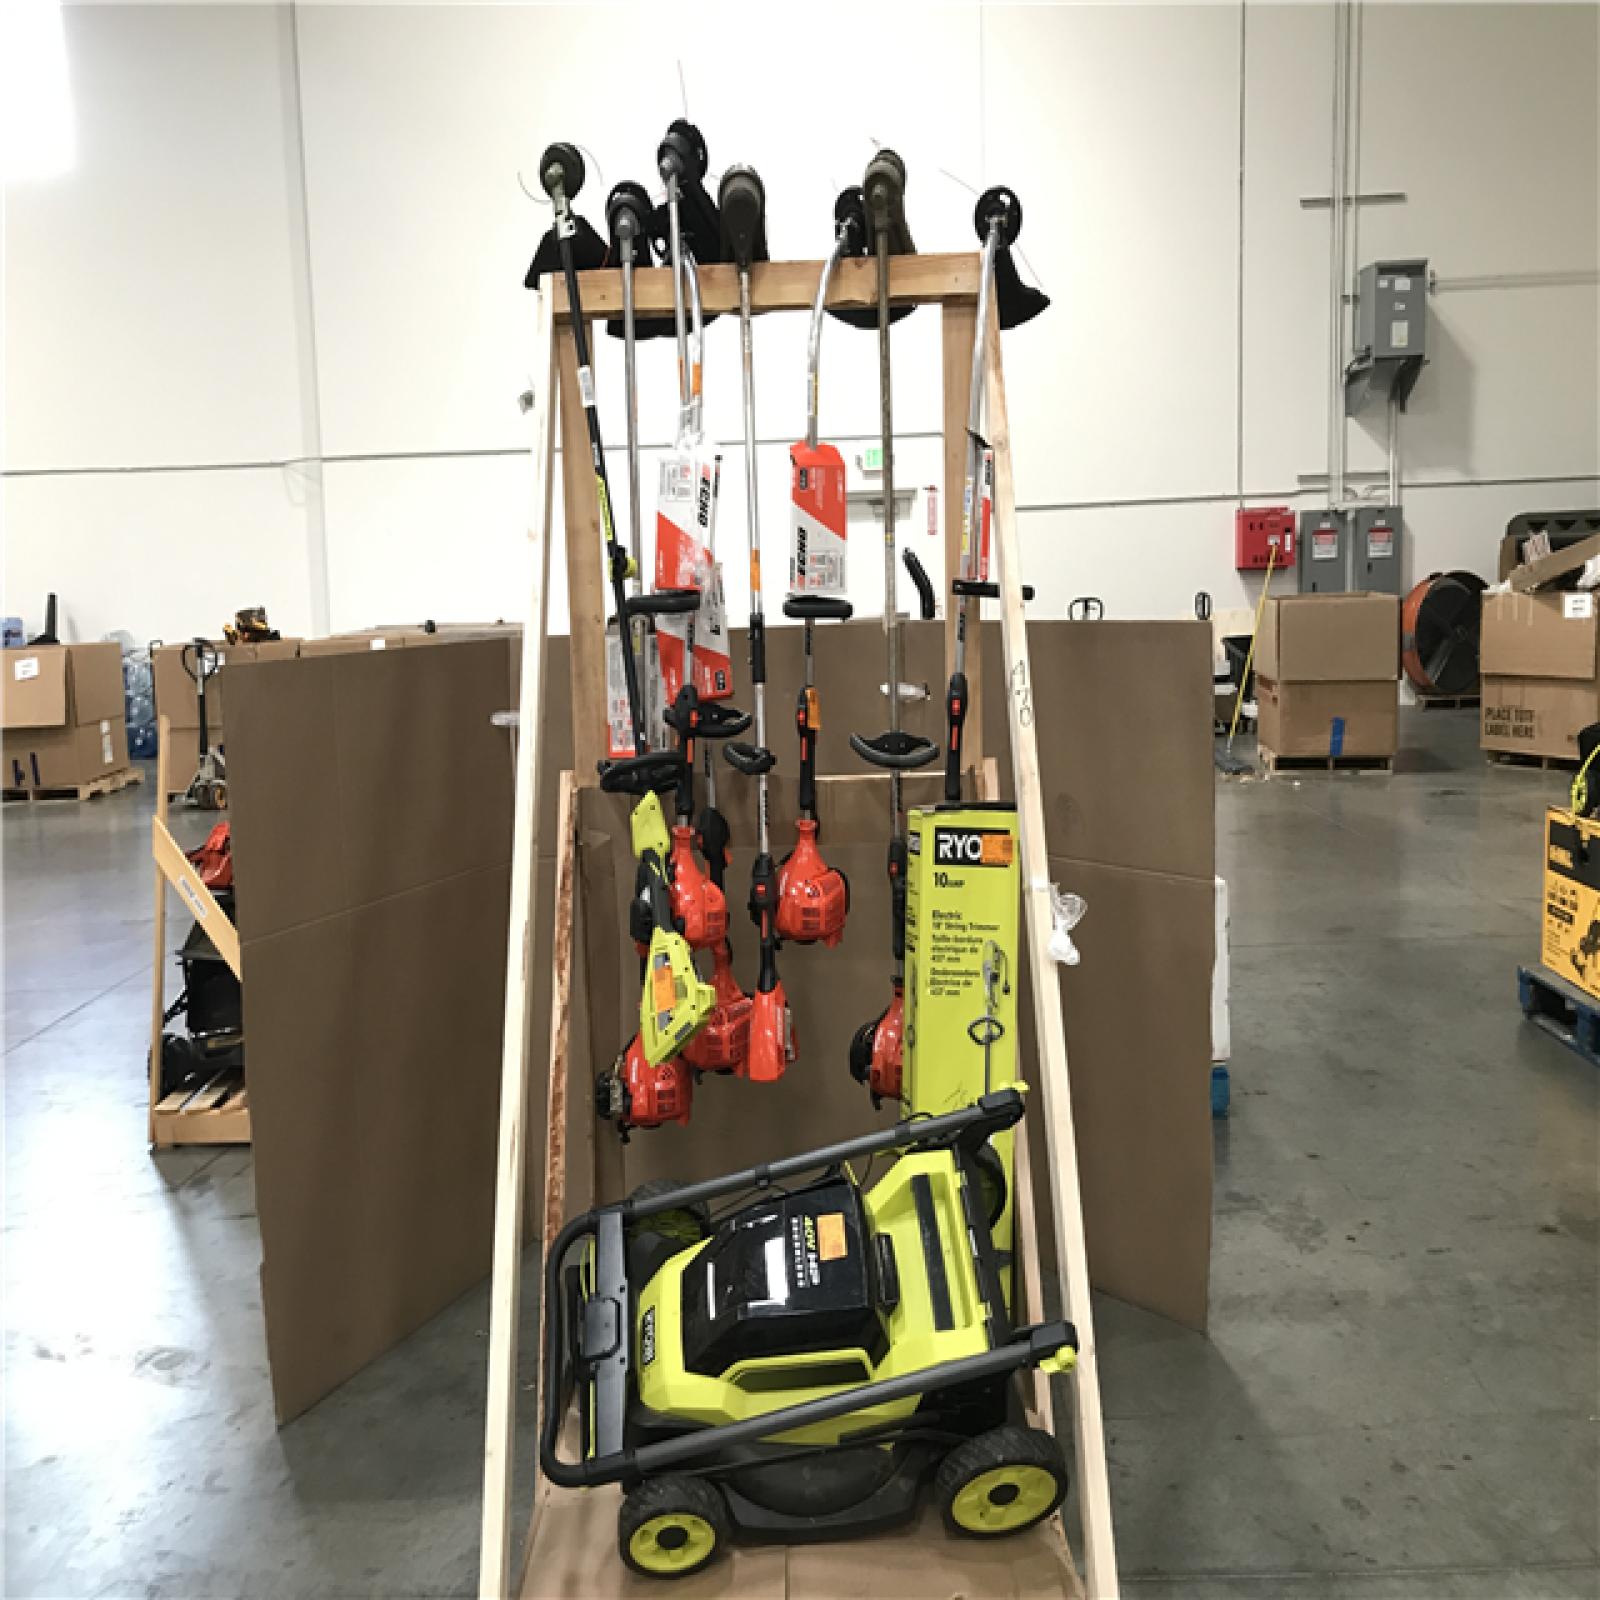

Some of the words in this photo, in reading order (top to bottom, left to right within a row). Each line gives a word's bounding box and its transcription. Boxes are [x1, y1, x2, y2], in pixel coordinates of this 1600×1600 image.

[697, 476, 711, 528] ECHO
[796, 527, 808, 576] ECHO
[937, 834, 981, 860] RYO
[804, 1215, 816, 1250] 40V
